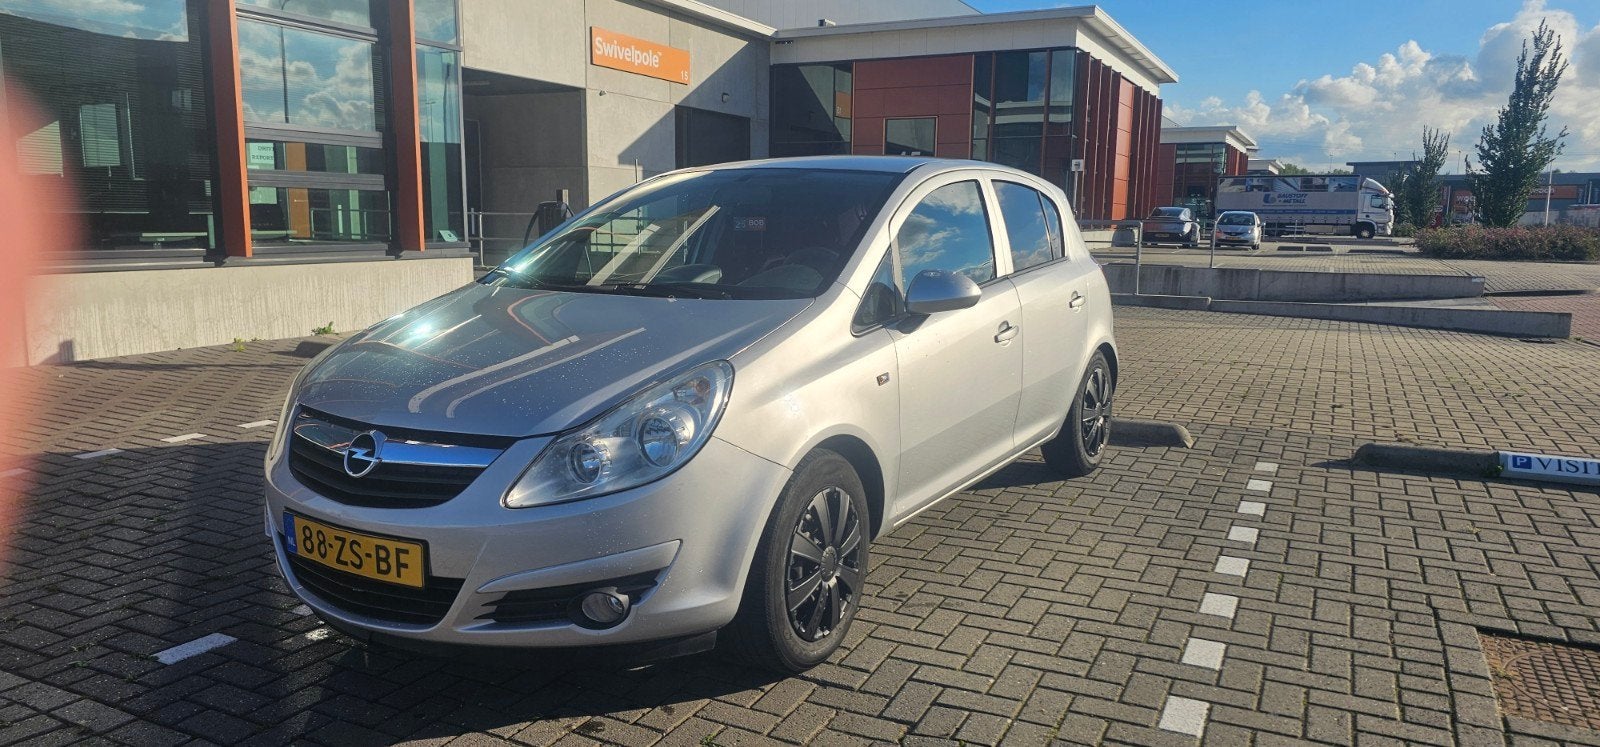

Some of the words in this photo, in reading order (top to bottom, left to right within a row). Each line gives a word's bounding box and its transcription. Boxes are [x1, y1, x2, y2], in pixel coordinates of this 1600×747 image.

[595, 37, 660, 68] Swivelpole
[681, 70, 688, 81] 15
[302, 525, 410, 579] 88-ZS-BF
